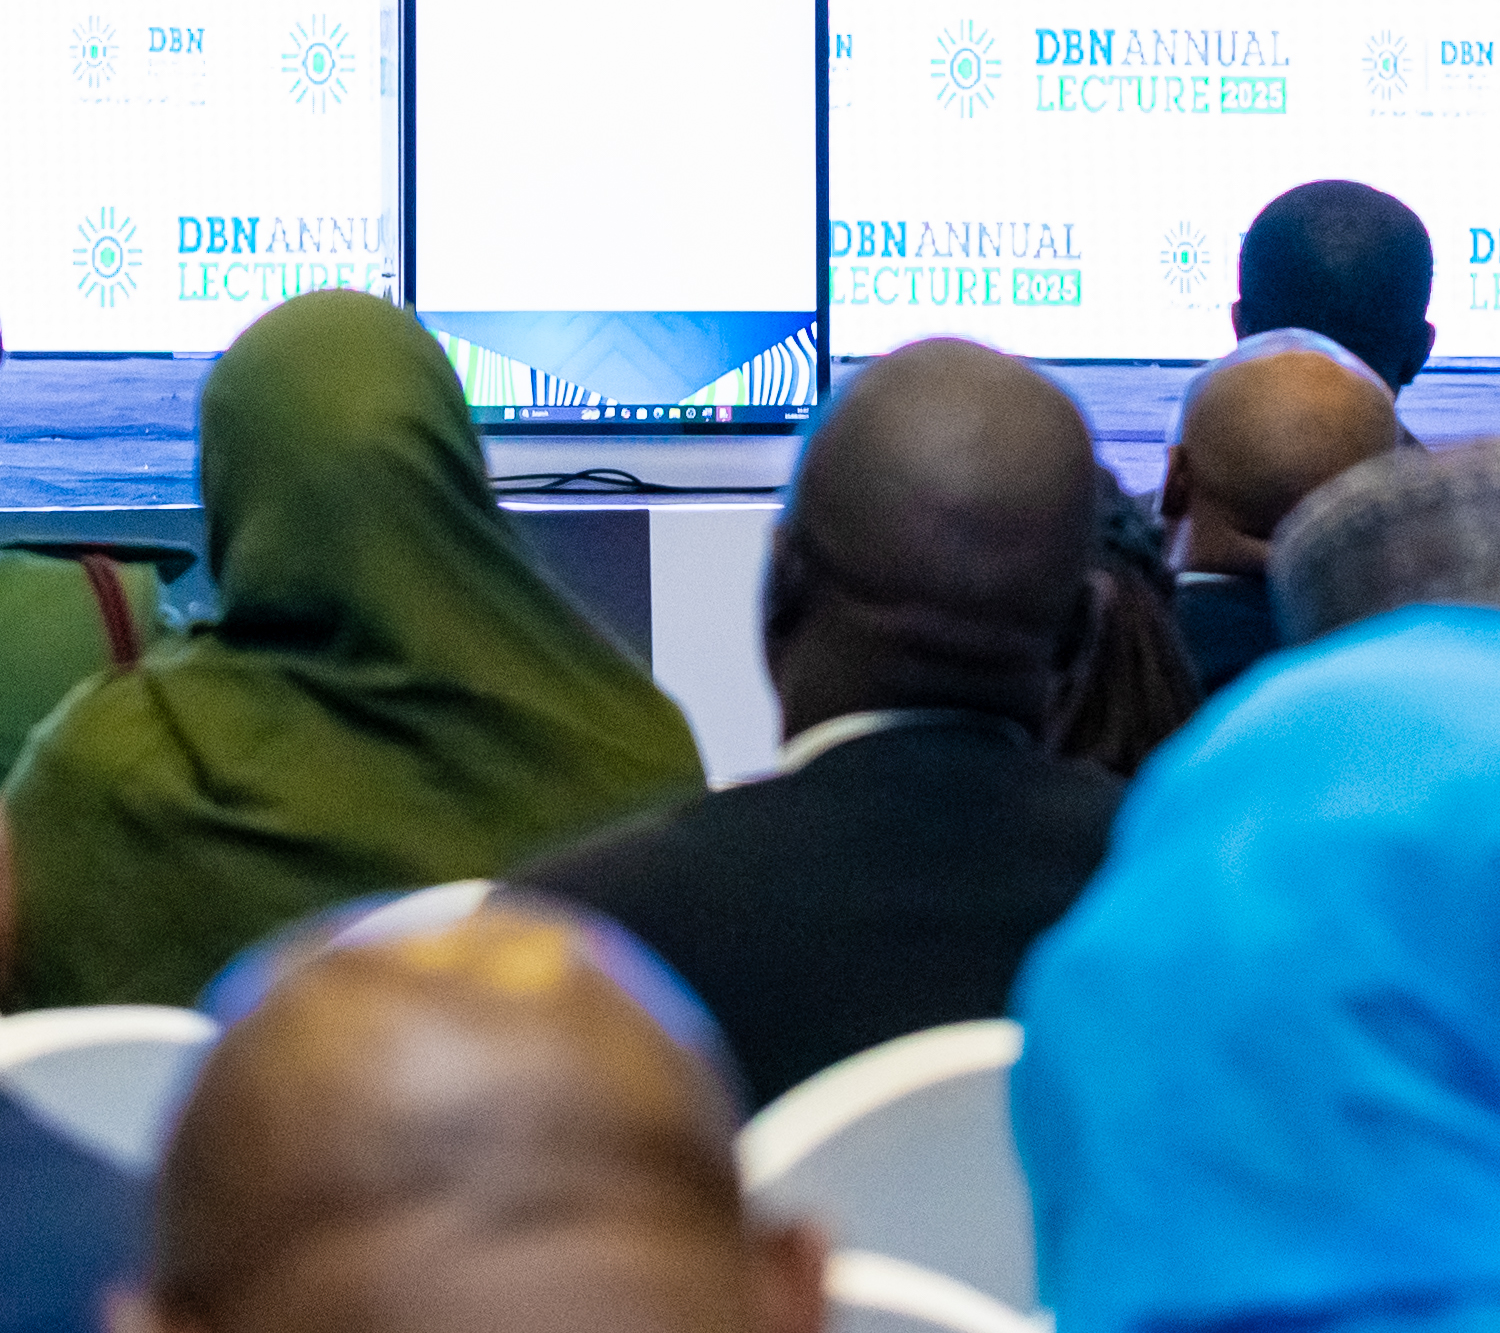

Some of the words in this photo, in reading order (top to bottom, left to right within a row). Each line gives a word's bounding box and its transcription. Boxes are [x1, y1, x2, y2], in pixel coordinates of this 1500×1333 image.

[148, 27, 205, 54] DBN
[1035, 28, 1115, 66] DBN
[1122, 29, 1289, 67] ANNUAL
[1441, 41, 1494, 67] DBN
[1037, 75, 1209, 113] LECTURE
[1222, 81, 1284, 110] 2025
[178, 216, 260, 254] DBN
[266, 217, 381, 253] ANNU
[830, 220, 907, 258] DBN
[915, 222, 1081, 260] ANNUAL
[829, 266, 1001, 305] LECTURE
[1014, 273, 1079, 303] 2025
